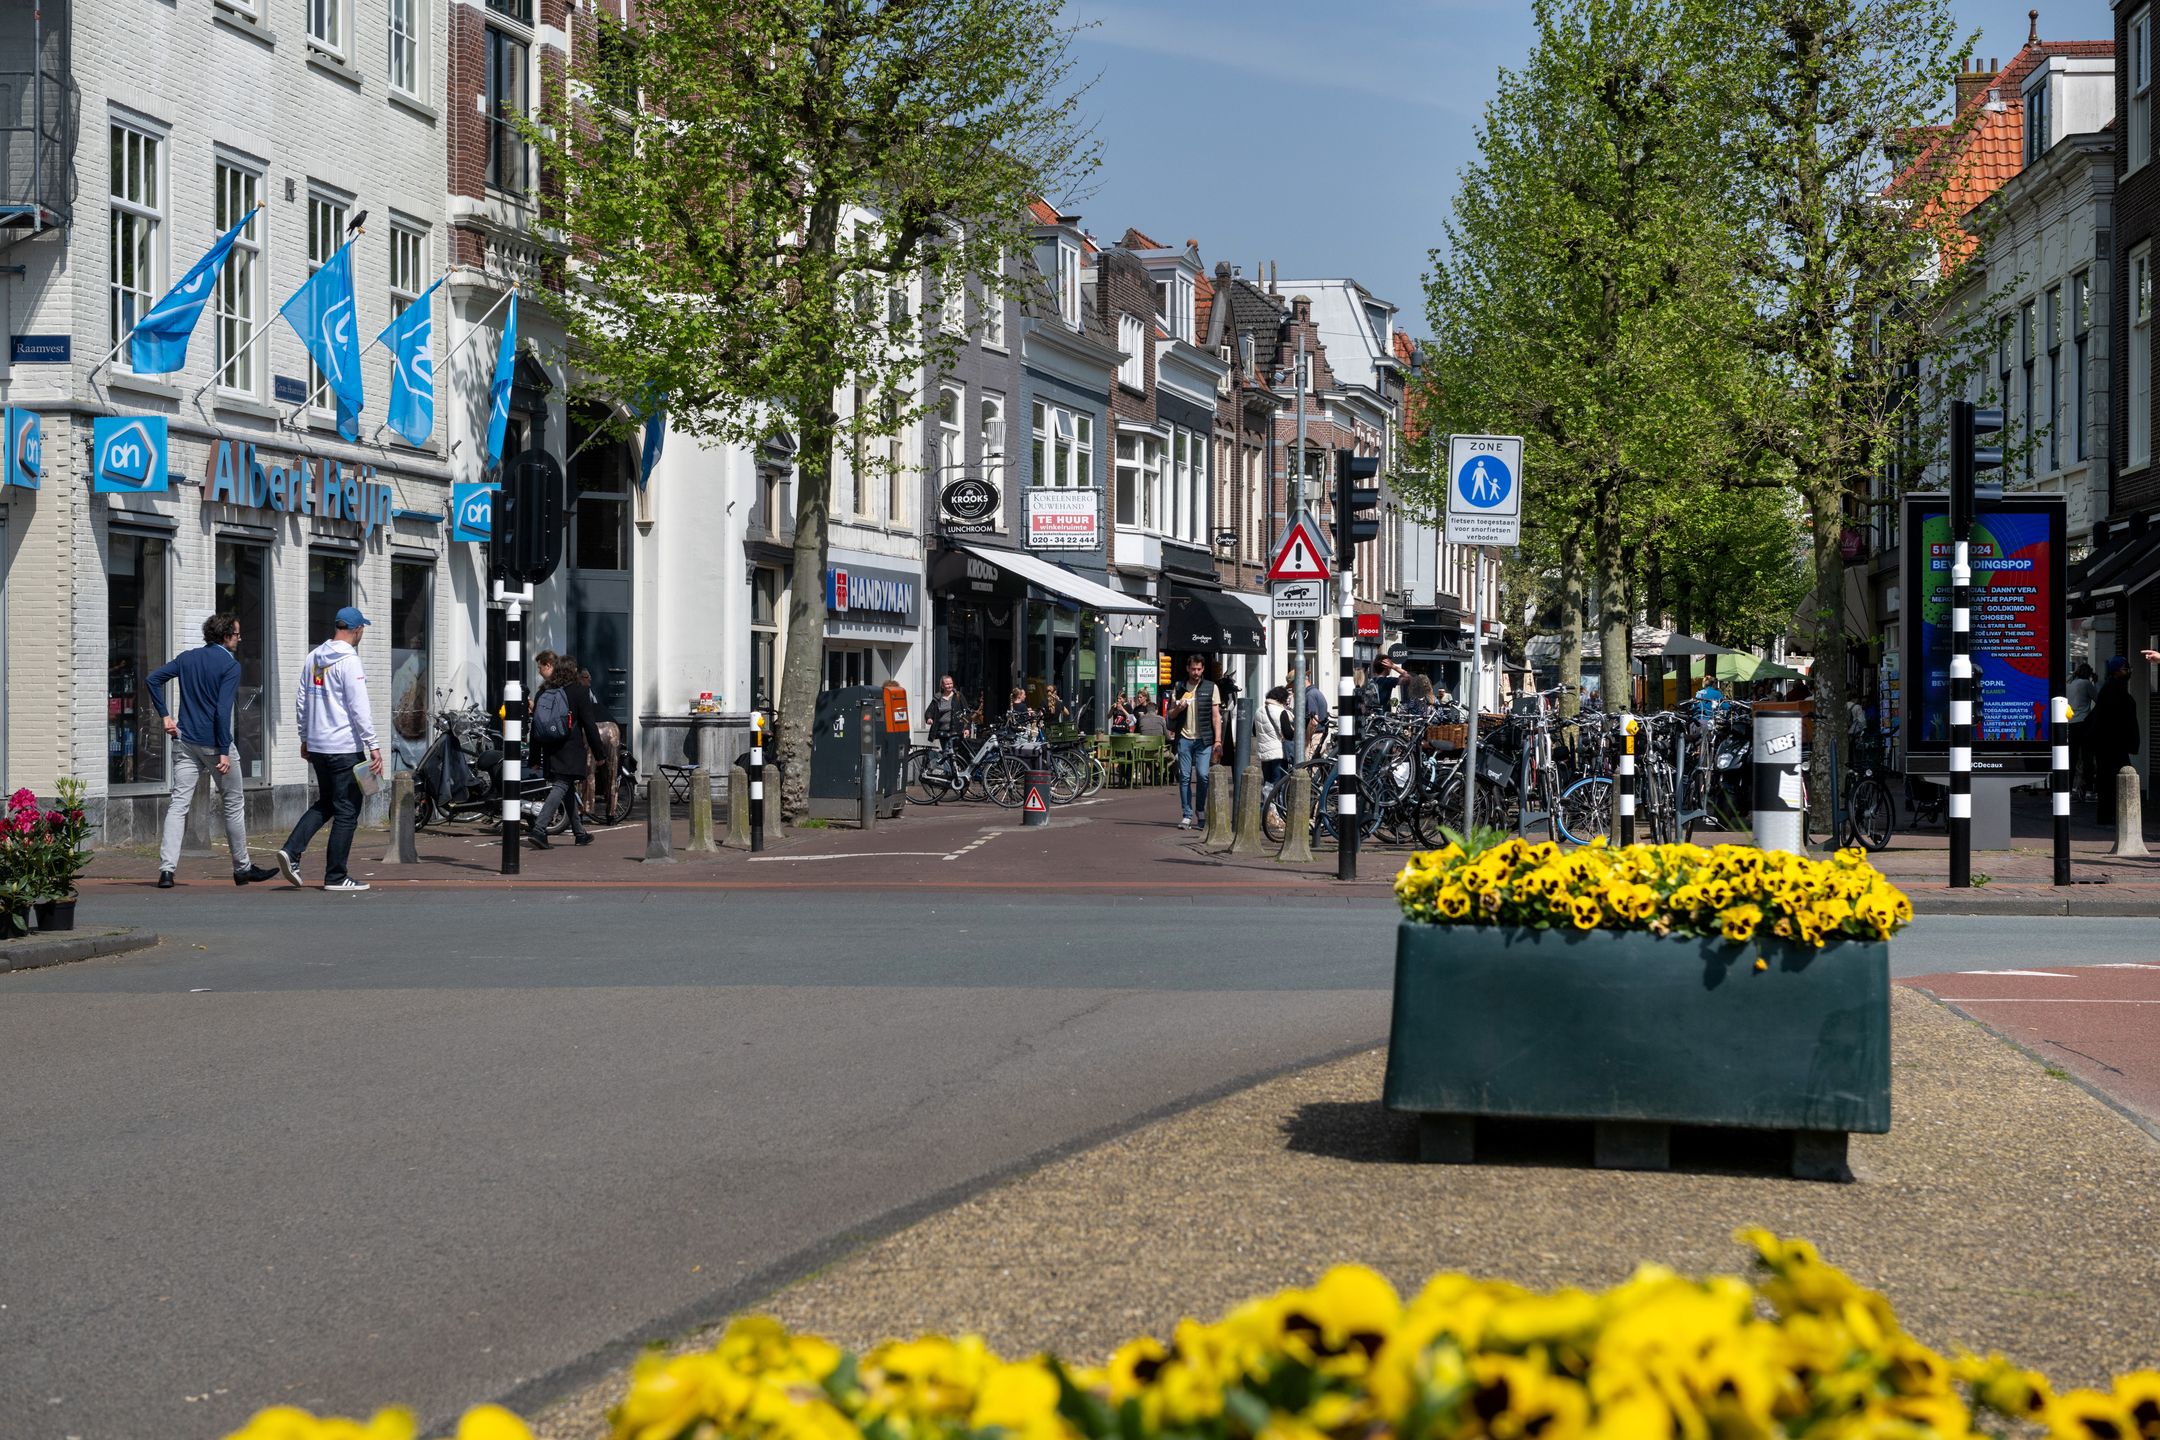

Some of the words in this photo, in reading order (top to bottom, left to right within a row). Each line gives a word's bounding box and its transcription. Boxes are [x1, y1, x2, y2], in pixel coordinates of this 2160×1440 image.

[16, 343, 65, 353] Raamvest
[1470, 442, 1503, 451] ZONE
[207, 439, 312, 516] Albert
[318, 457, 393, 539] Heijn
[951, 495, 989, 504] KROOKS
[1034, 494, 1093, 502] KOKELENBERG
[1037, 516, 1053, 524] TE
[1056, 516, 1089, 524] HUUR
[948, 525, 993, 533] LUNCHROOM
[1932, 545, 1939, 554] 5
[967, 558, 999, 581] KROOKS
[849, 576, 913, 614] HANDYMAN
[1766, 734, 1796, 753] NBF
